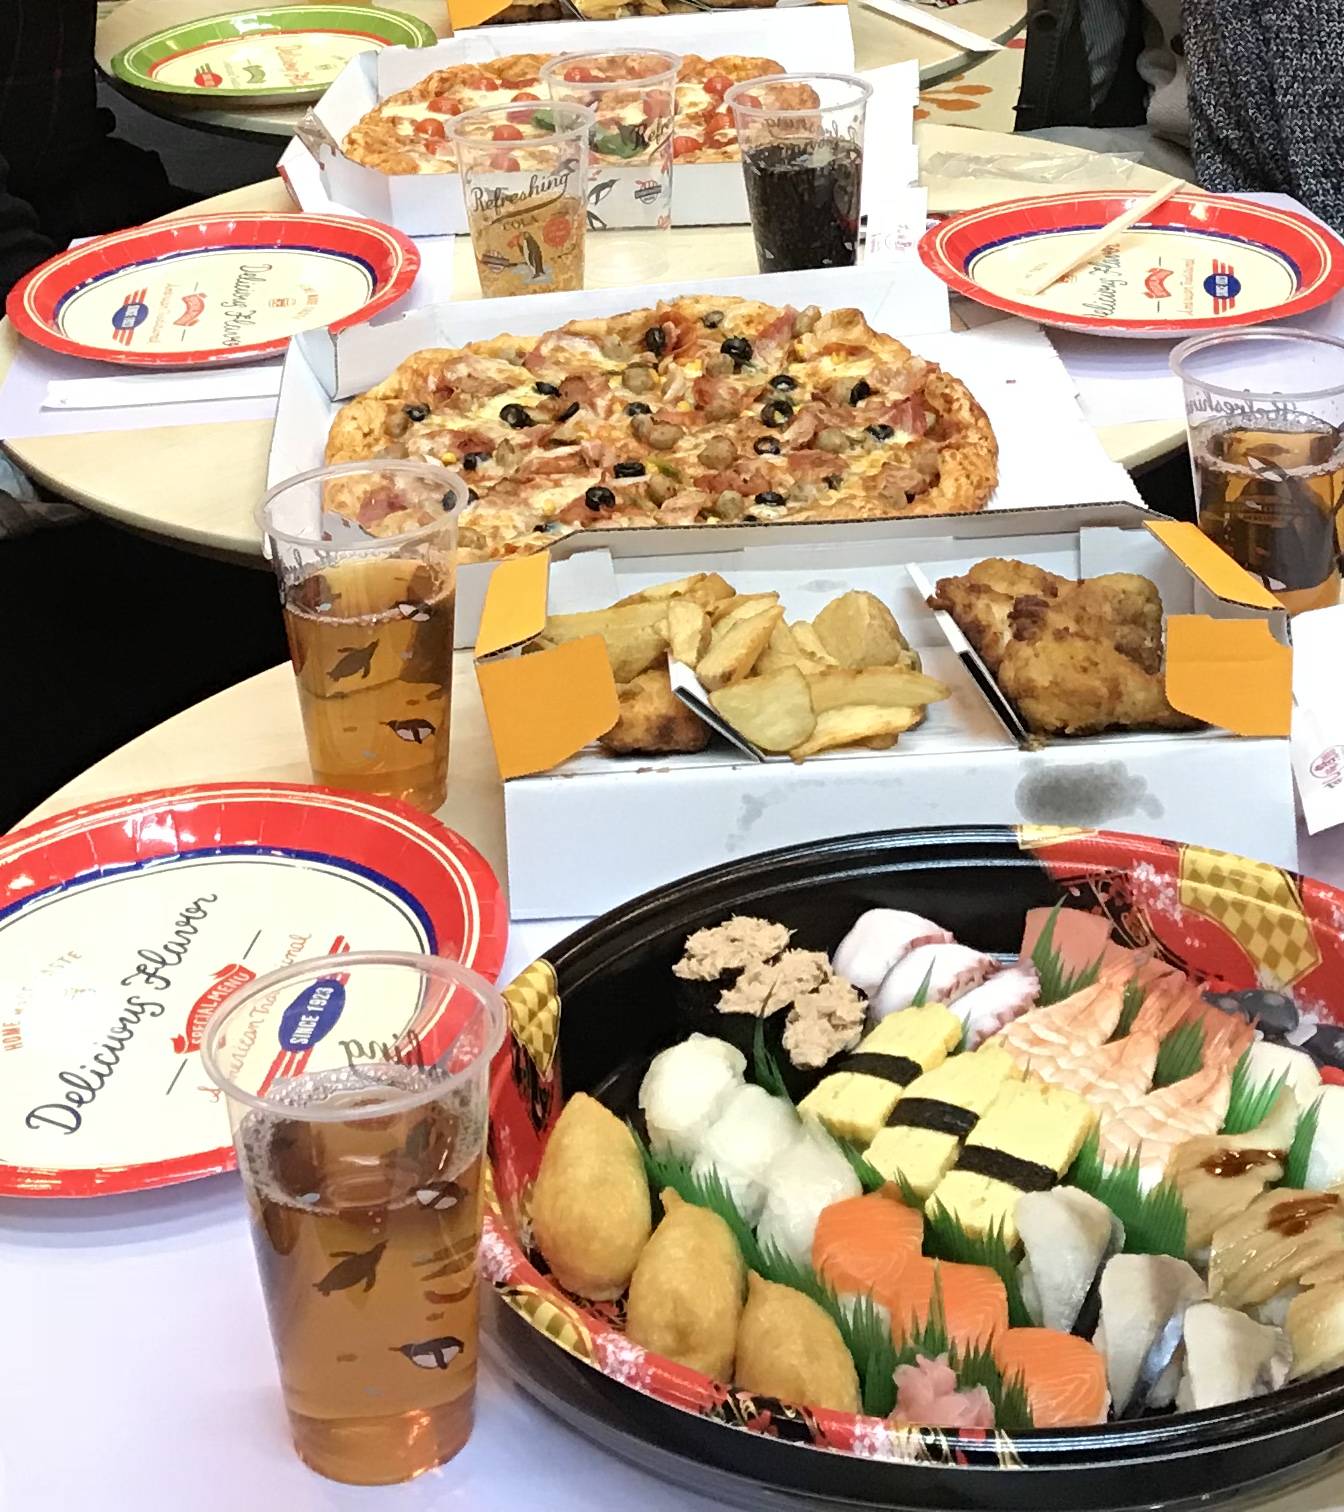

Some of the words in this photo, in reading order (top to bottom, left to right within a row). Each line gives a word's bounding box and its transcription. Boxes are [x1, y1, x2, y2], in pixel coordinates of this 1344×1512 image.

[471, 171, 570, 218] Refreshing
[502, 215, 539, 231] COLA
[25, 995, 166, 1136] Delicious
[120, 893, 218, 991] Flavor
[191, 994, 219, 1045] SPECIAL
[212, 972, 251, 1002] MENU
[290, 1014, 320, 1045] SINCE
[307, 986, 335, 1012] 1923
